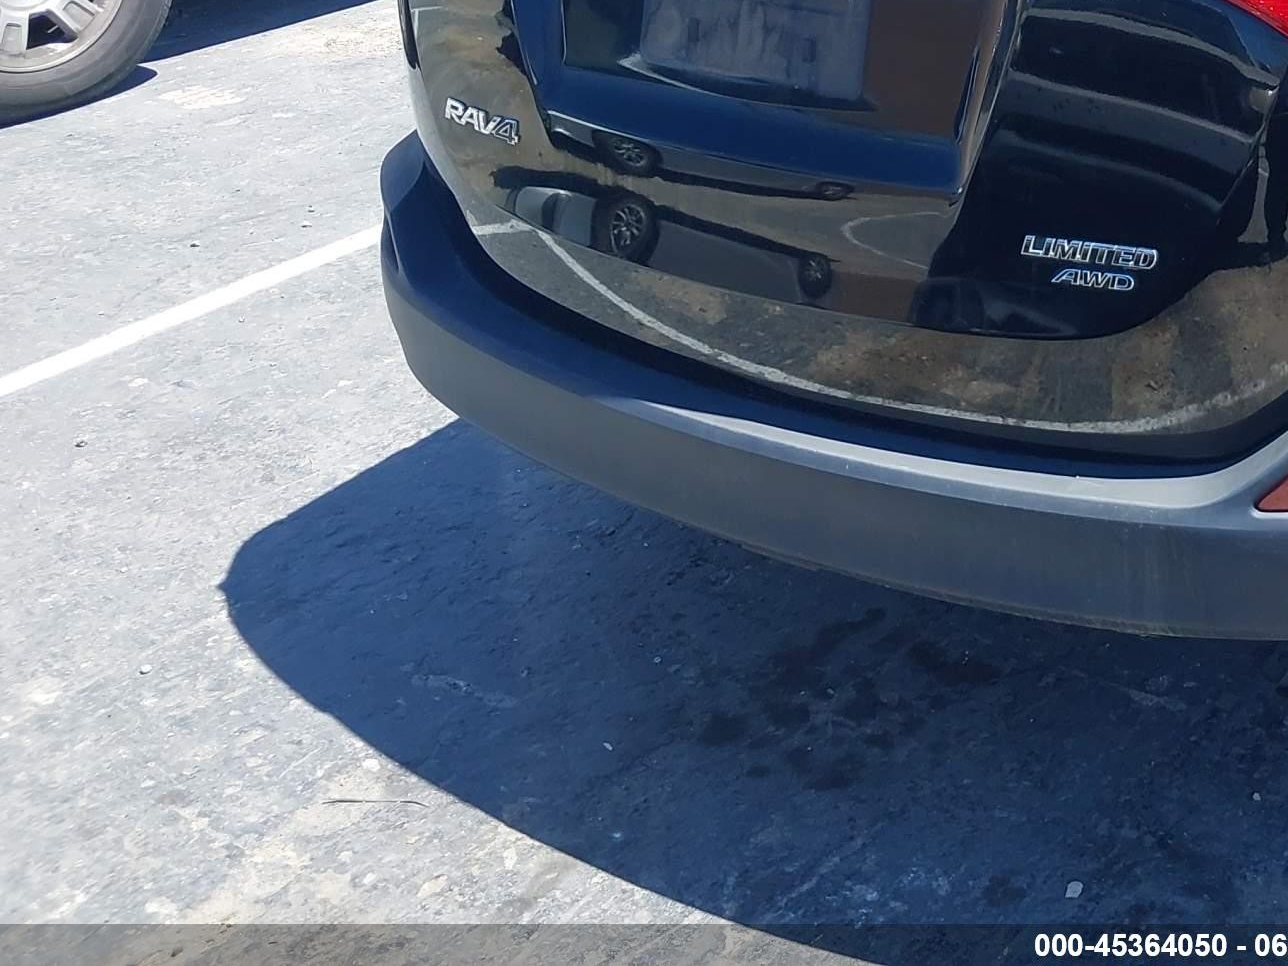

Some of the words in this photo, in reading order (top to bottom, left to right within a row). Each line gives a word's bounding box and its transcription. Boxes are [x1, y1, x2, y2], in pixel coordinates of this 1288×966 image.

[444, 97, 520, 146] RAV4
[1020, 234, 1159, 270] LIMITED
[1051, 268, 1135, 291] AWD
